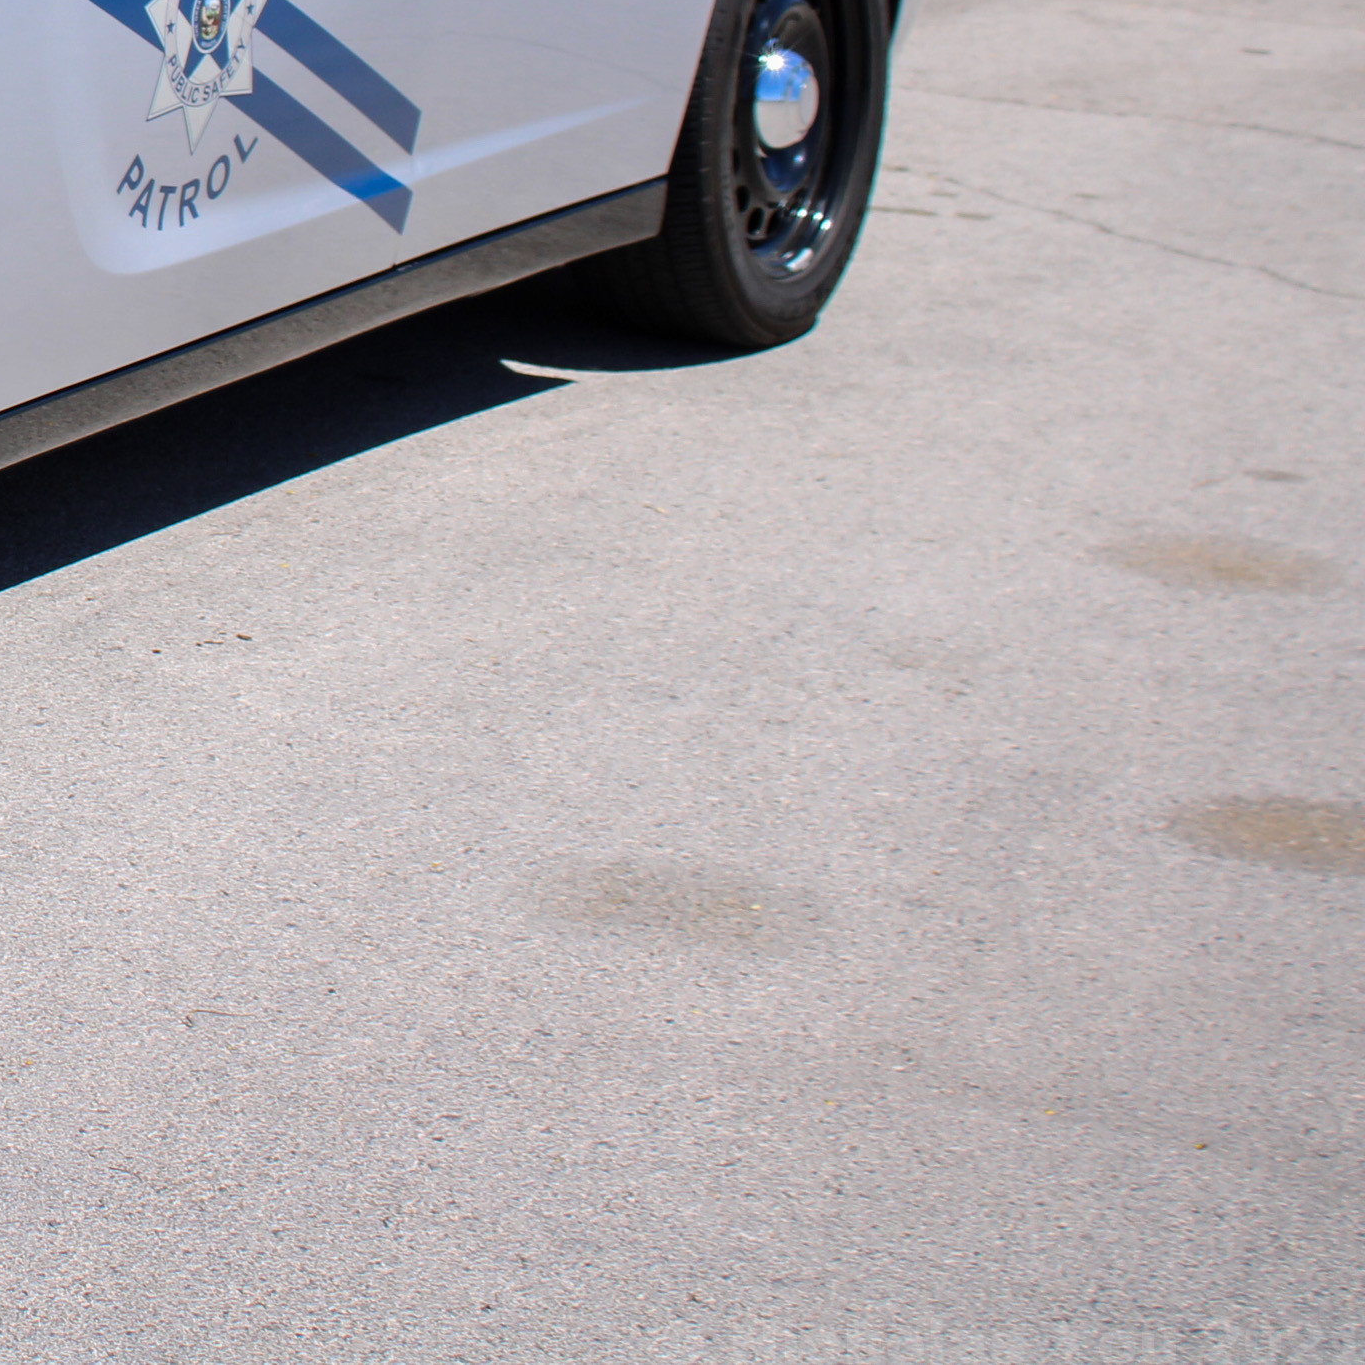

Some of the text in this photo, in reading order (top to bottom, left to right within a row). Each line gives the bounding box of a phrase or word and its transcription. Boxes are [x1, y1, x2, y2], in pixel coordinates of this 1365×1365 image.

[168, 37, 246, 104] PUBLIC SAFETY
[117, 134, 258, 231] PATROL
